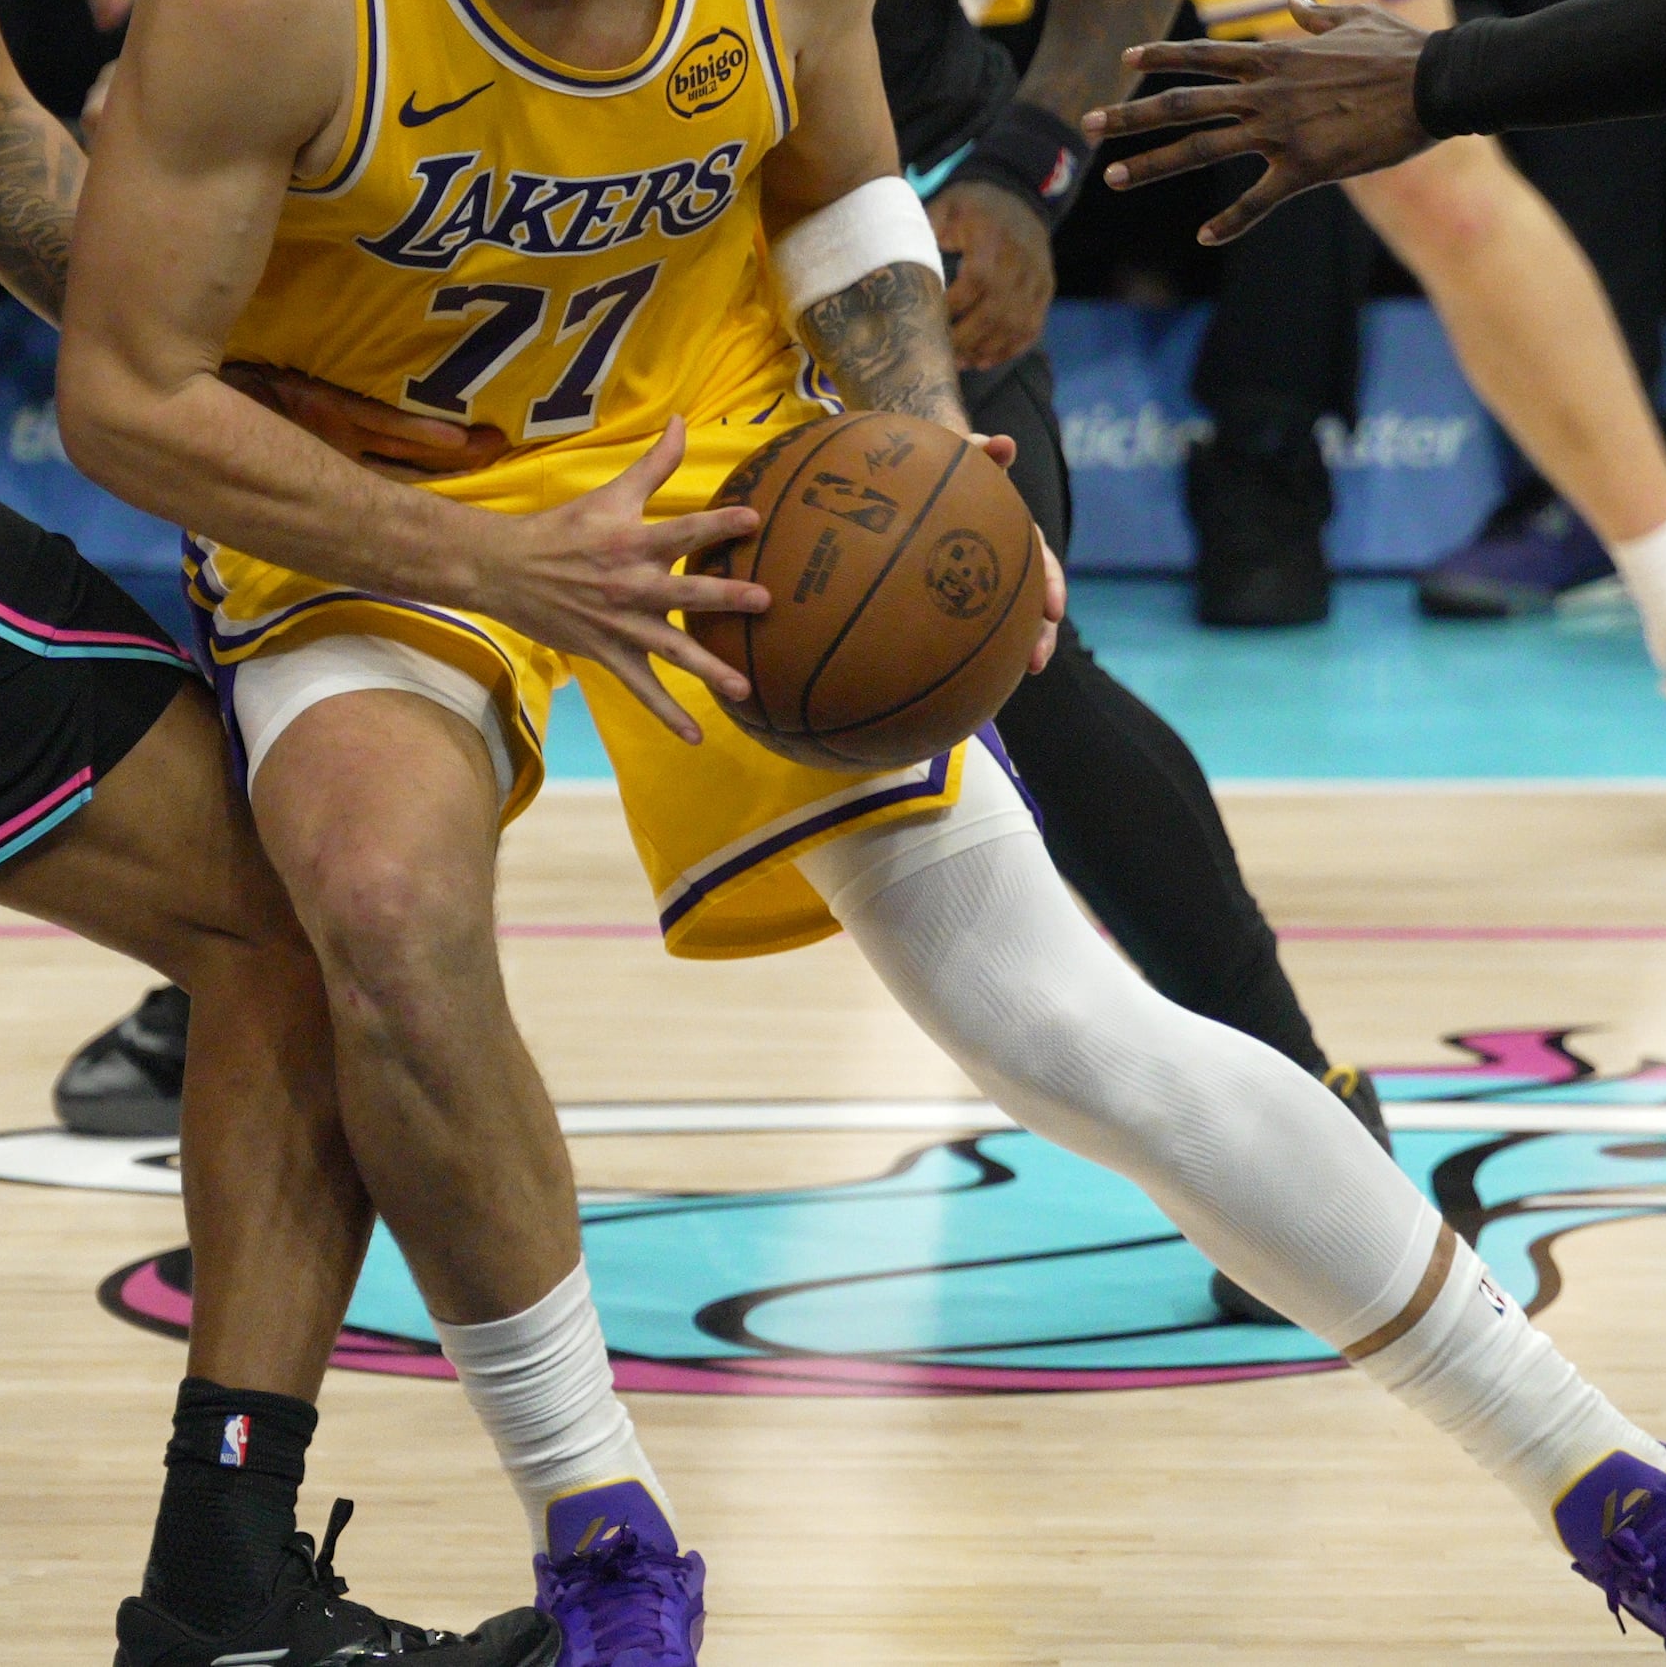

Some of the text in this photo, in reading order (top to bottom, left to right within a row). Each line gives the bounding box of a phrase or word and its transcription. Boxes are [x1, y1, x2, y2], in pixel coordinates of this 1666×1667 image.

[675, 49, 743, 95] bibigo
[353, 139, 748, 272] LAKERS
[399, 259, 668, 439] 77
